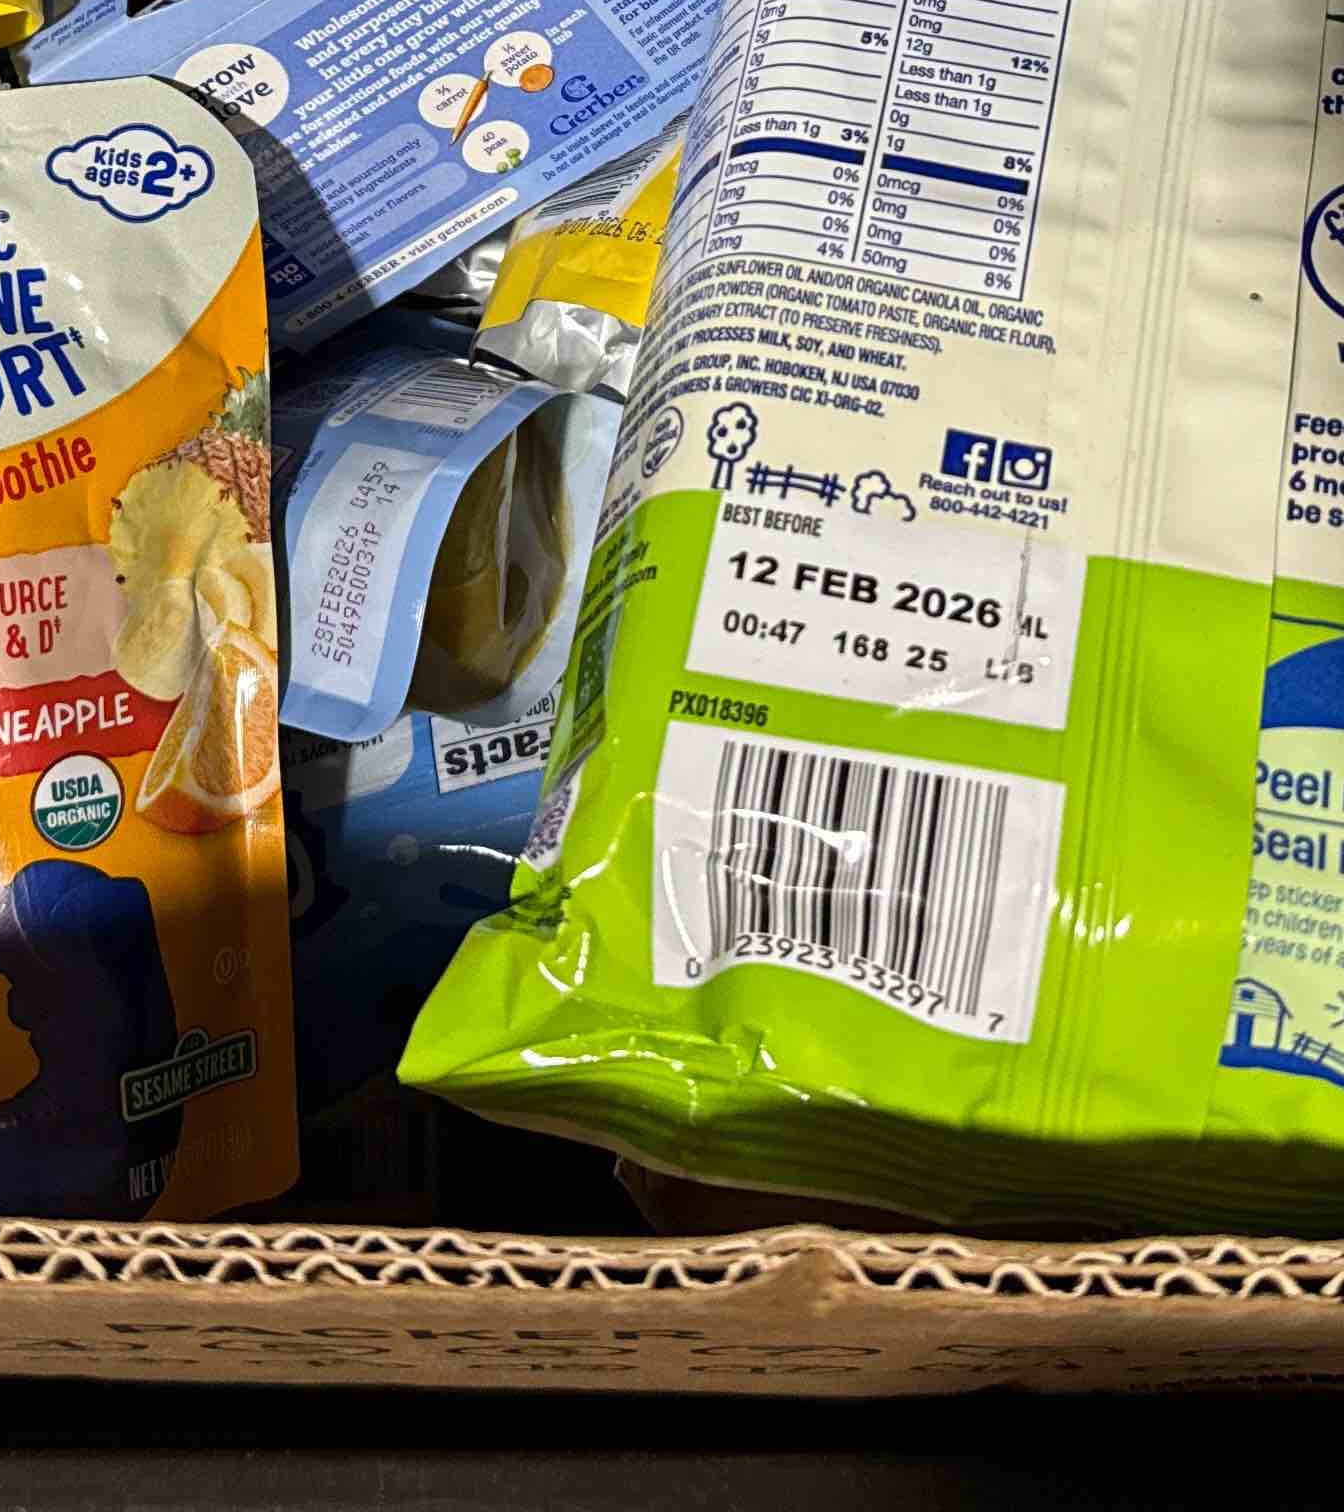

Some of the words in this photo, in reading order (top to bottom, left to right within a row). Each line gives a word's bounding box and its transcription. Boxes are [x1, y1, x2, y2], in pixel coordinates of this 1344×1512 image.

[406, 17, 450, 52] grow
[900, 61, 938, 83] Less
[941, 67, 974, 86] than
[977, 72, 995, 90] 1g
[1011, 56, 1049, 74] 12%
[85, 164, 140, 186] ages
[94, 147, 142, 168] kids
[141, 151, 195, 197] 2+
[438, 196, 507, 244] gerber.com
[723, 504, 761, 524] BEST
[764, 509, 822, 536] BEFORE
[929, 497, 1048, 530] 800-442-4221
[311, 524, 358, 659] 28FEB2026
[728, 551, 779, 585] 12
[793, 563, 878, 604] FEB
[894, 581, 1001, 627] 2026
[723, 610, 805, 646] 00:47
[833, 631, 889, 661] 168
[906, 646, 947, 673] 25
[668, 691, 768, 726] PX018396
[52, 772, 104, 802] USDA
[47, 799, 110, 826] ORGANIC
[1277, 886, 1343, 912] sticker
[736, 934, 836, 971] 23923
[855, 959, 943, 1015] 53297
